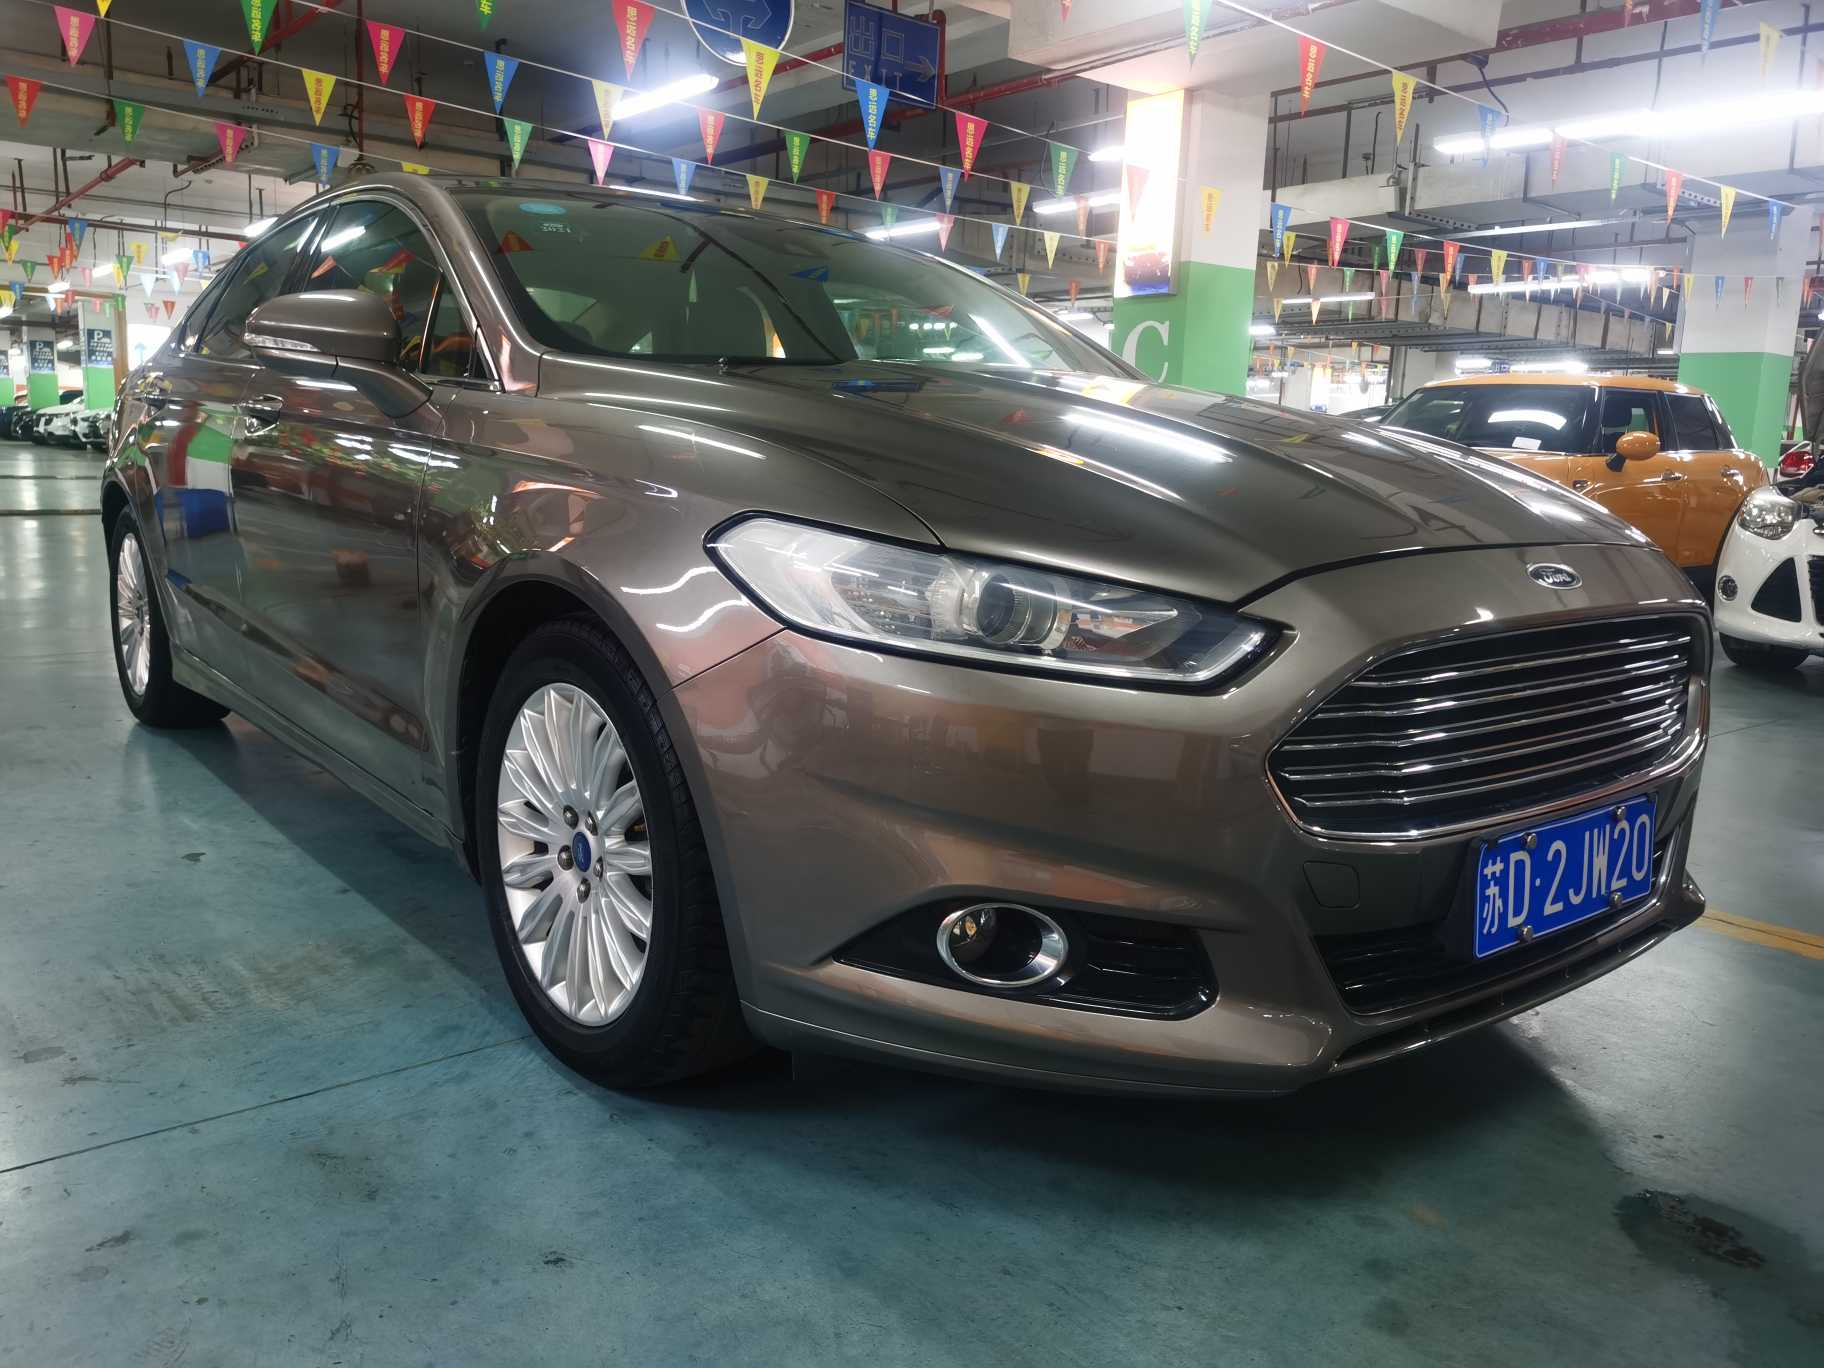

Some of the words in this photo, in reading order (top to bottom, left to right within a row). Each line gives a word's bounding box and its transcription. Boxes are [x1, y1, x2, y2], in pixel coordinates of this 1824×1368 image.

[849, 15, 905, 64] 出口
[849, 60, 903, 92] EXIT
[1121, 320, 1170, 383] C
